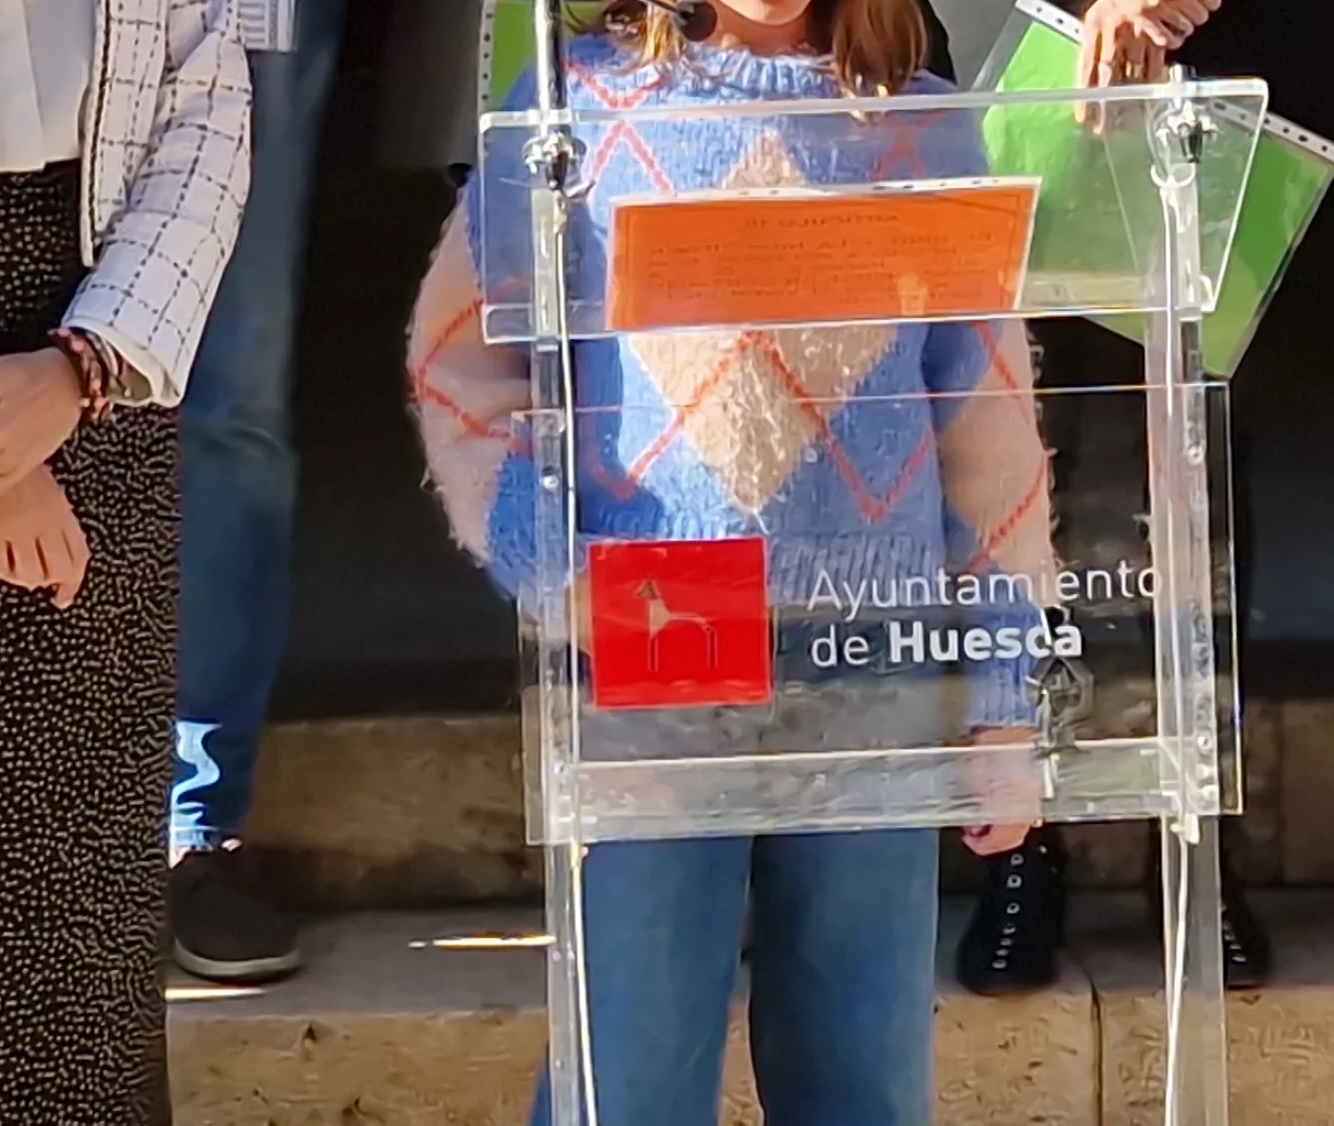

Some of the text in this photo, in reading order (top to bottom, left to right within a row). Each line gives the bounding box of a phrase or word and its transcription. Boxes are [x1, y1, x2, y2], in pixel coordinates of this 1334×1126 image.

[807, 559, 1163, 621] Ayuntamiento
[811, 620, 1082, 667] de Huesca
